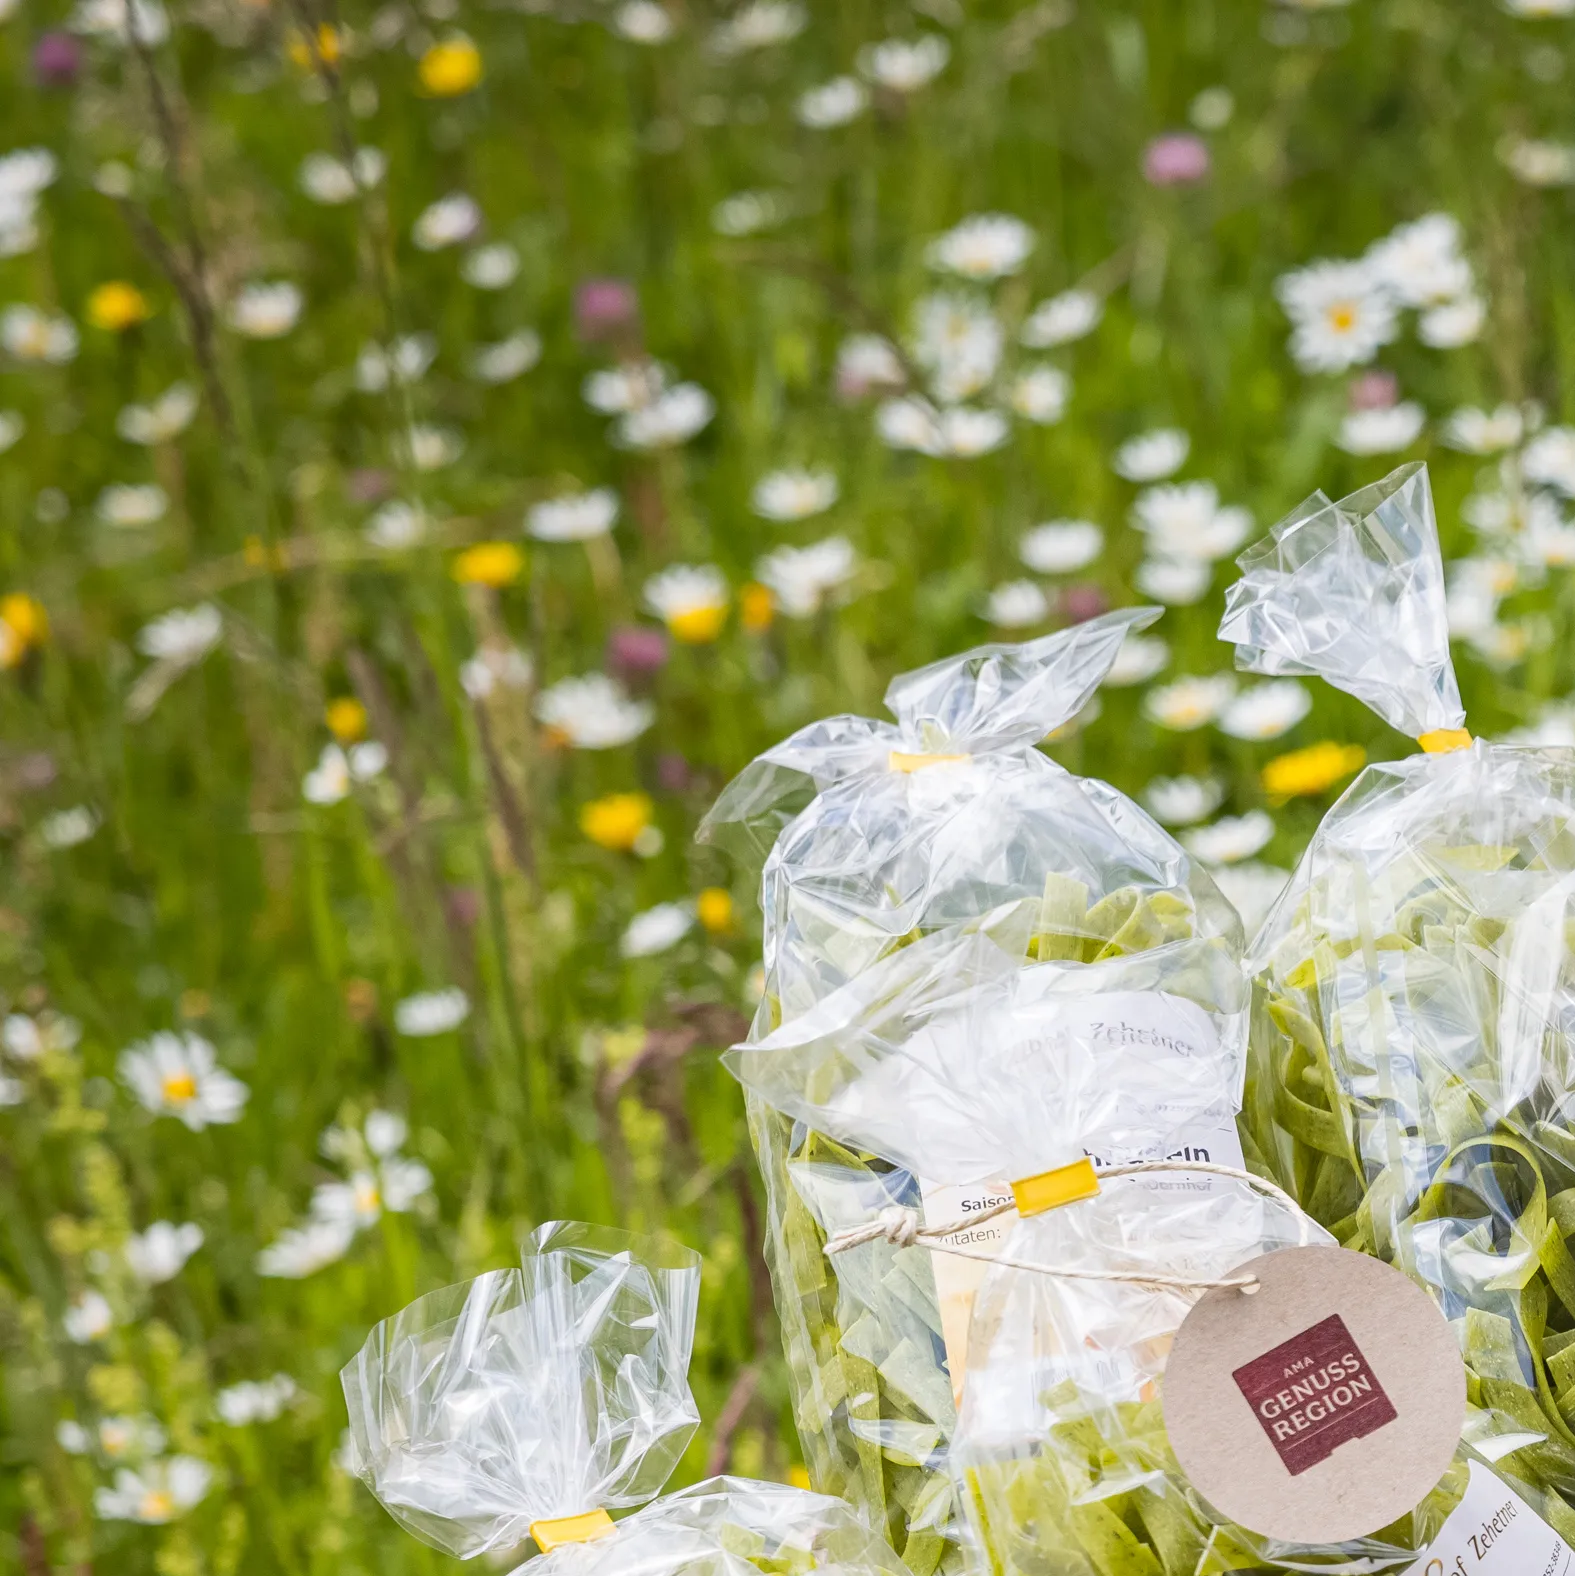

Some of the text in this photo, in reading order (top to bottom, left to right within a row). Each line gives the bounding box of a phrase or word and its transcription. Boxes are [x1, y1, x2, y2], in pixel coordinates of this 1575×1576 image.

[1260, 1353, 1360, 1419] GENUSS
[1283, 1356, 1314, 1378] AMA
[1272, 1374, 1373, 1441] REGION
[1467, 1500, 1519, 1561] Zehetner
